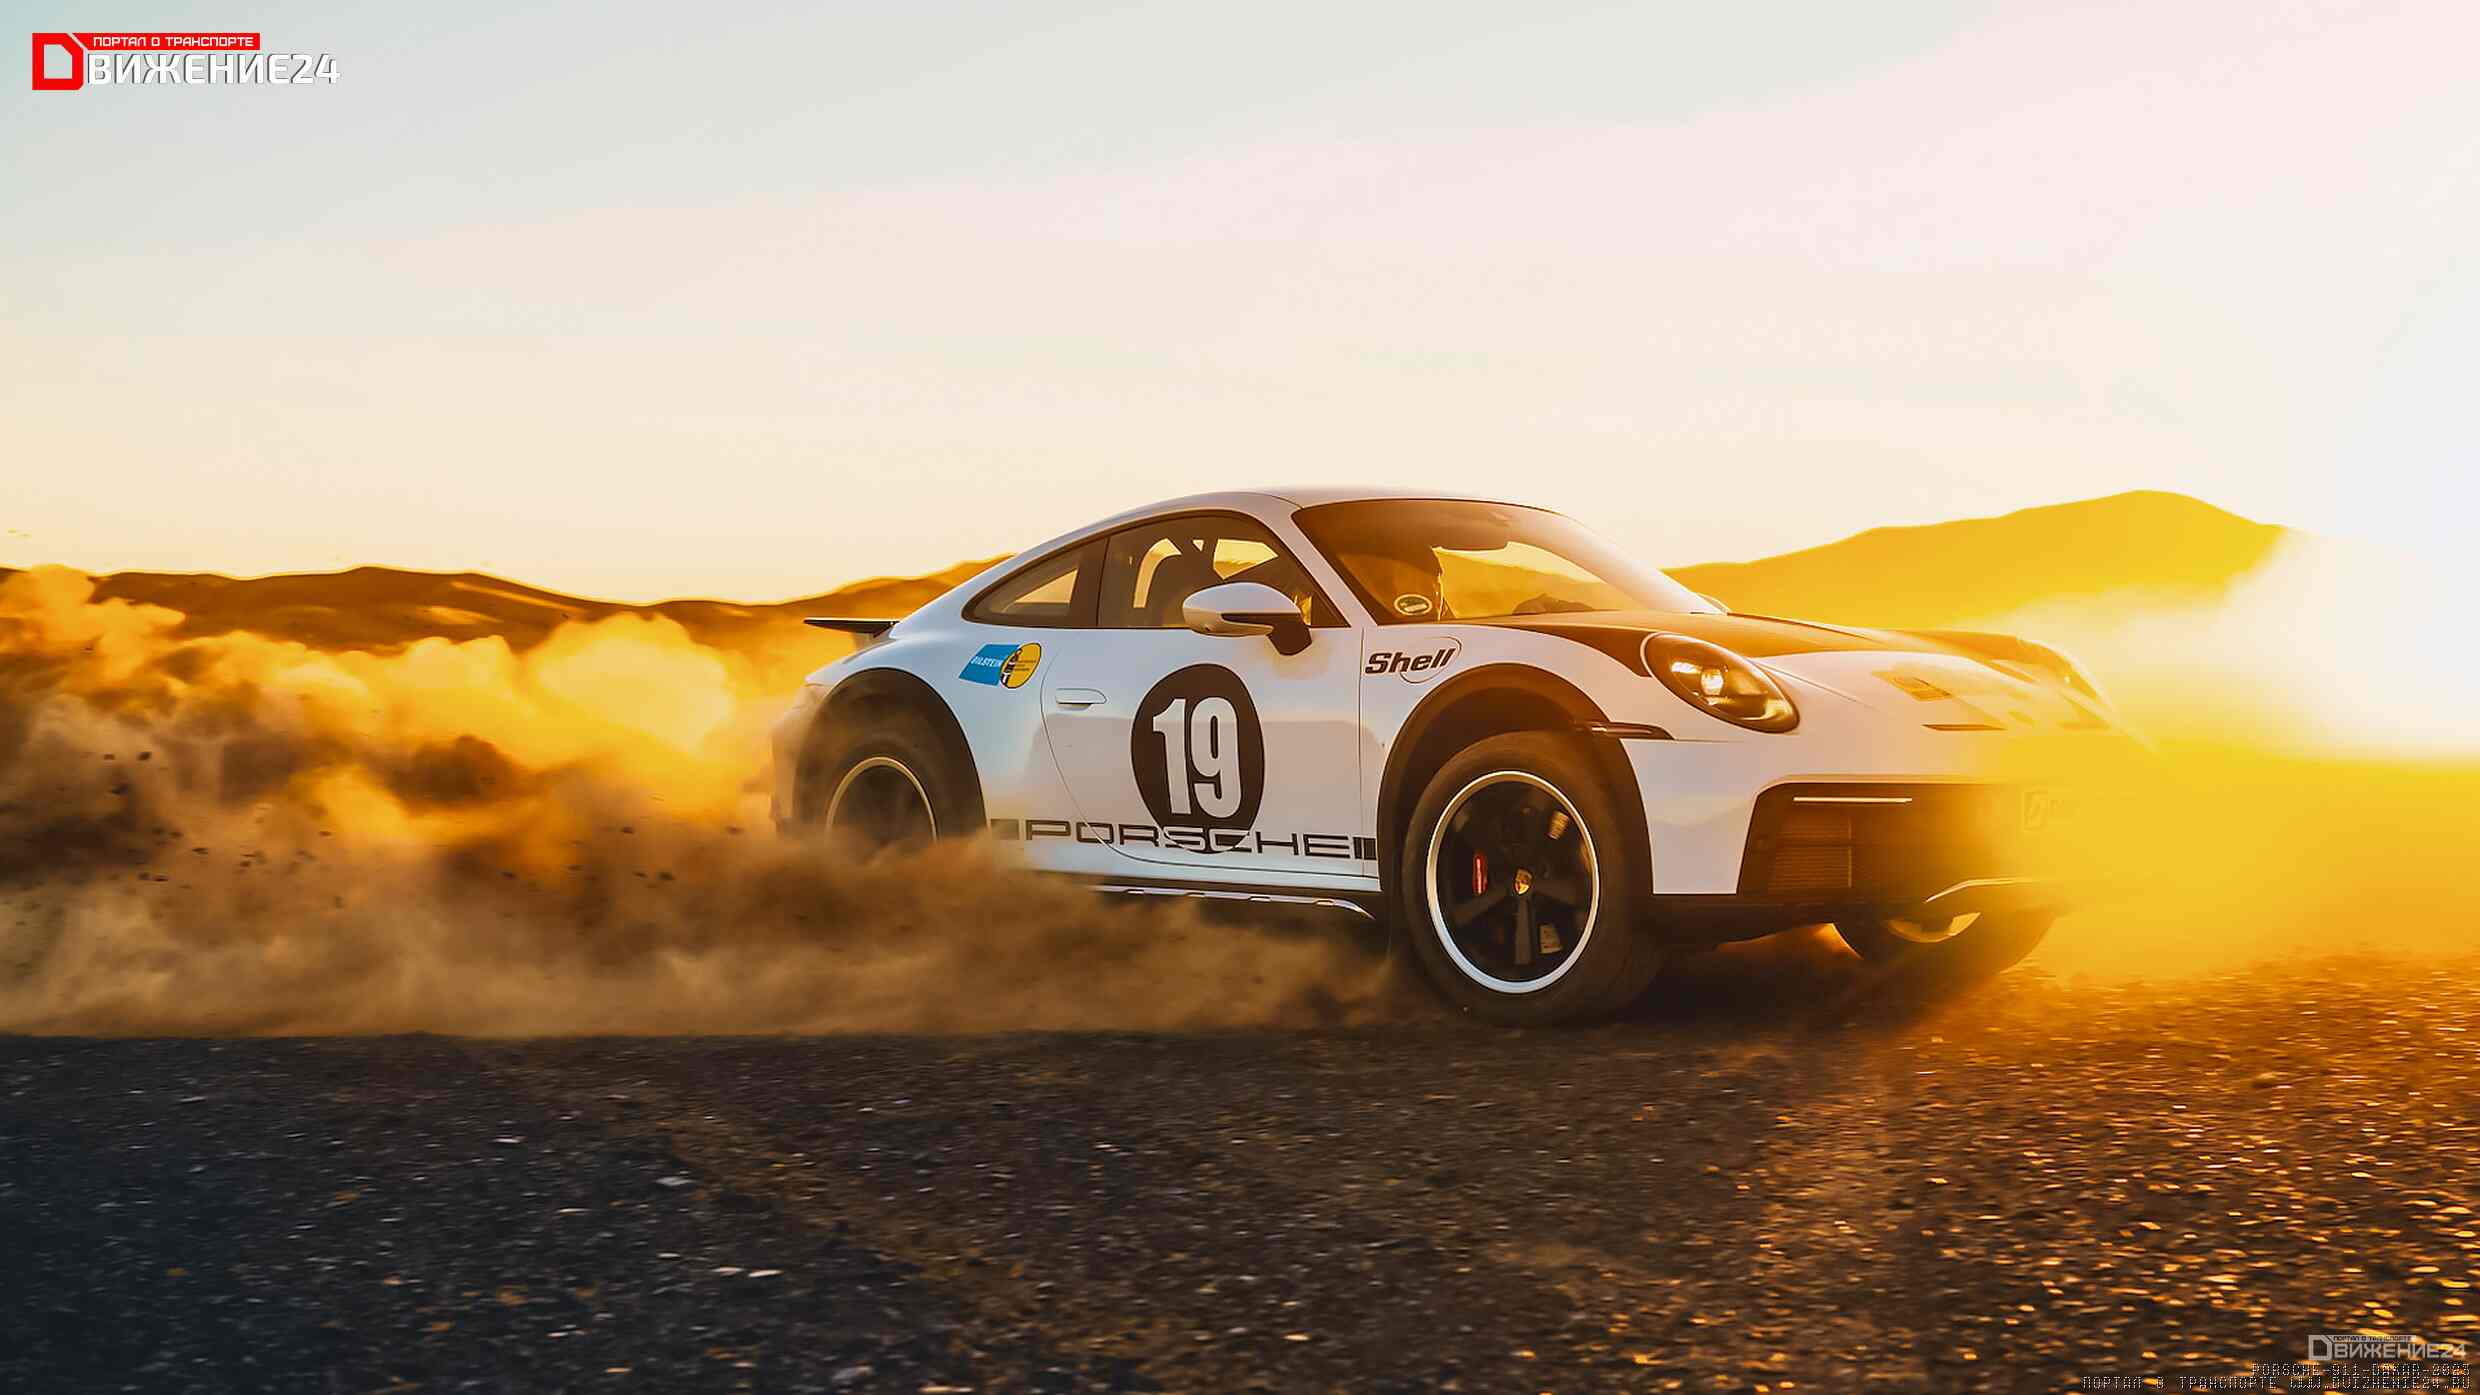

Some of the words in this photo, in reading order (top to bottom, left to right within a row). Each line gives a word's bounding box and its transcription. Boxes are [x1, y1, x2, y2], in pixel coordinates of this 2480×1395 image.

[1365, 648, 1456, 674] Shell
[1152, 697, 1241, 818] 19
[1026, 820, 1350, 858] PORSCHE
